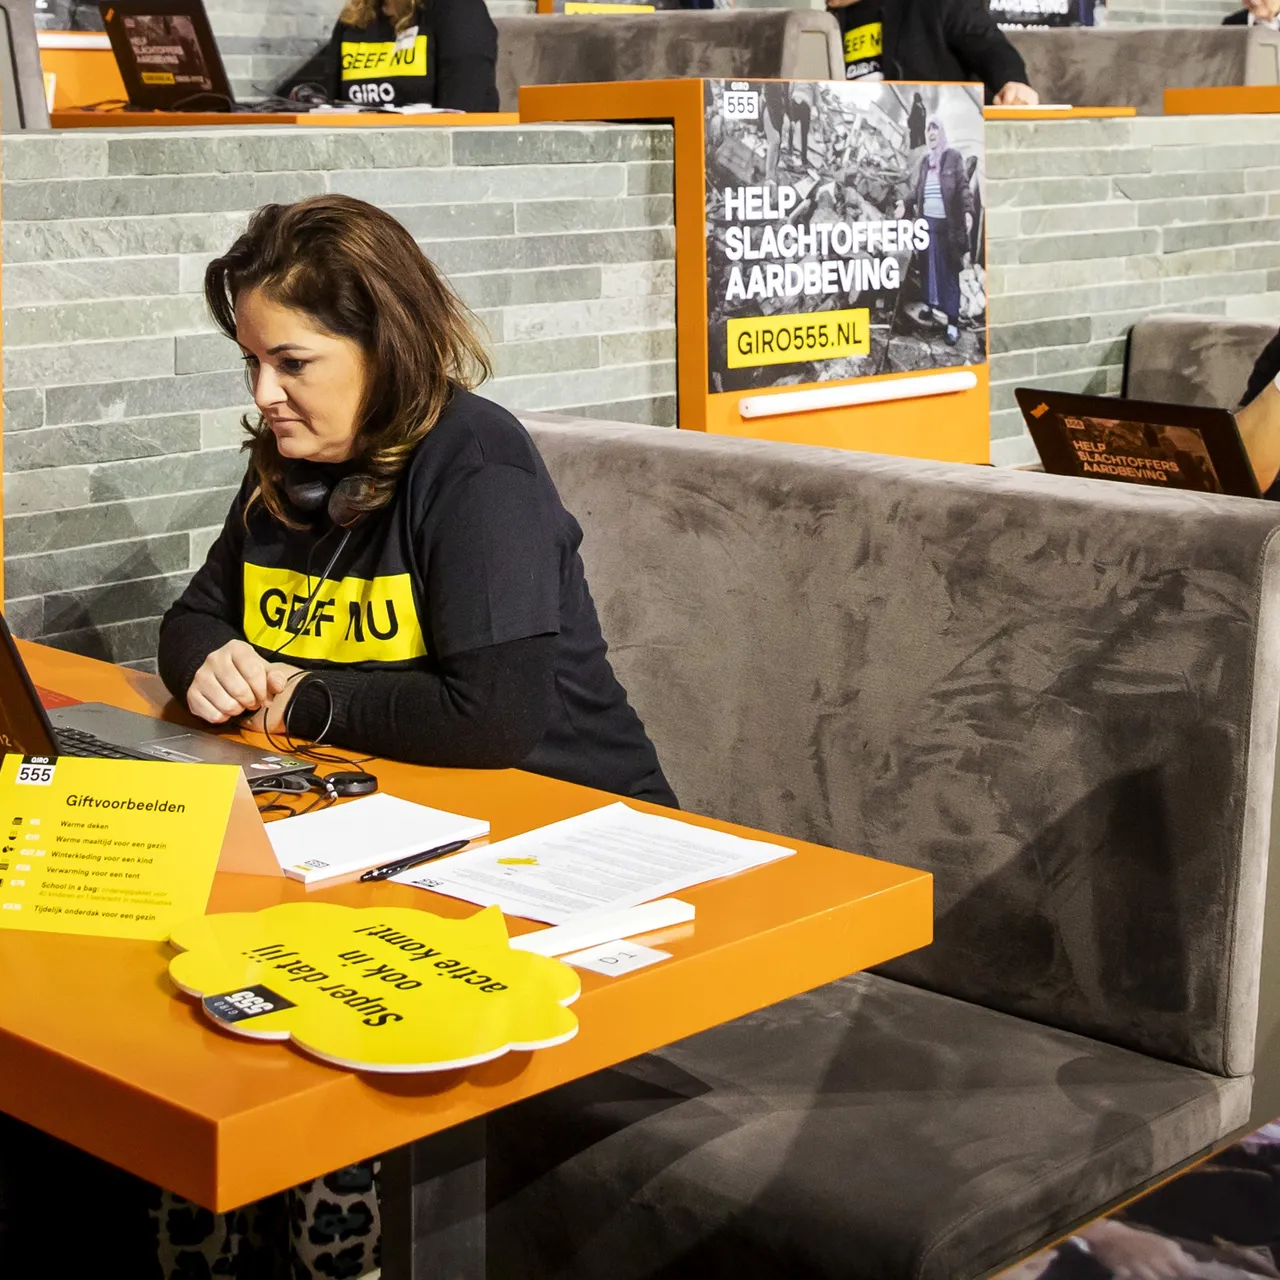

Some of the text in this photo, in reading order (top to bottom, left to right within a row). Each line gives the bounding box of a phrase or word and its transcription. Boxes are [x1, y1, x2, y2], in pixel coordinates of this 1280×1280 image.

[341, 51, 388, 71] GEEF
[348, 82, 396, 104] GIRO
[727, 96, 757, 115] 555
[724, 186, 798, 221] HELP
[724, 218, 930, 261] SLACHTOFFERS
[725, 257, 900, 301] AARDBEVING
[736, 324, 863, 356] GIRO555.NL
[1072, 440, 1107, 453] HELP
[1077, 451, 1180, 473] SLACHTOFFERS
[1083, 461, 1168, 482] AARDBEVING
[344, 599, 399, 643] NU
[30, 756, 50, 764] GIRO
[19, 766, 52, 782] 555
[65, 794, 186, 814] Giftvoorbeelden
[60, 820, 109, 830] Warme deken
[55, 835, 81, 844] Warme
[82, 837, 112, 847] maaltijd
[146, 842, 167, 850] gezin
[51, 850, 102, 862] Winterkleding
[137, 856, 154, 864] kind
[46, 866, 89, 877] Verwarming
[41, 881, 67, 890] School
[33, 905, 63, 914] Tijdelijk
[64, 908, 99, 917] onderdak
[135, 913, 156, 921] gezin
[352, 924, 509, 993] actie komt!
[337, 949, 423, 991] ook in
[241, 944, 404, 1027] Super dat jij
[224, 990, 275, 1015] 555
